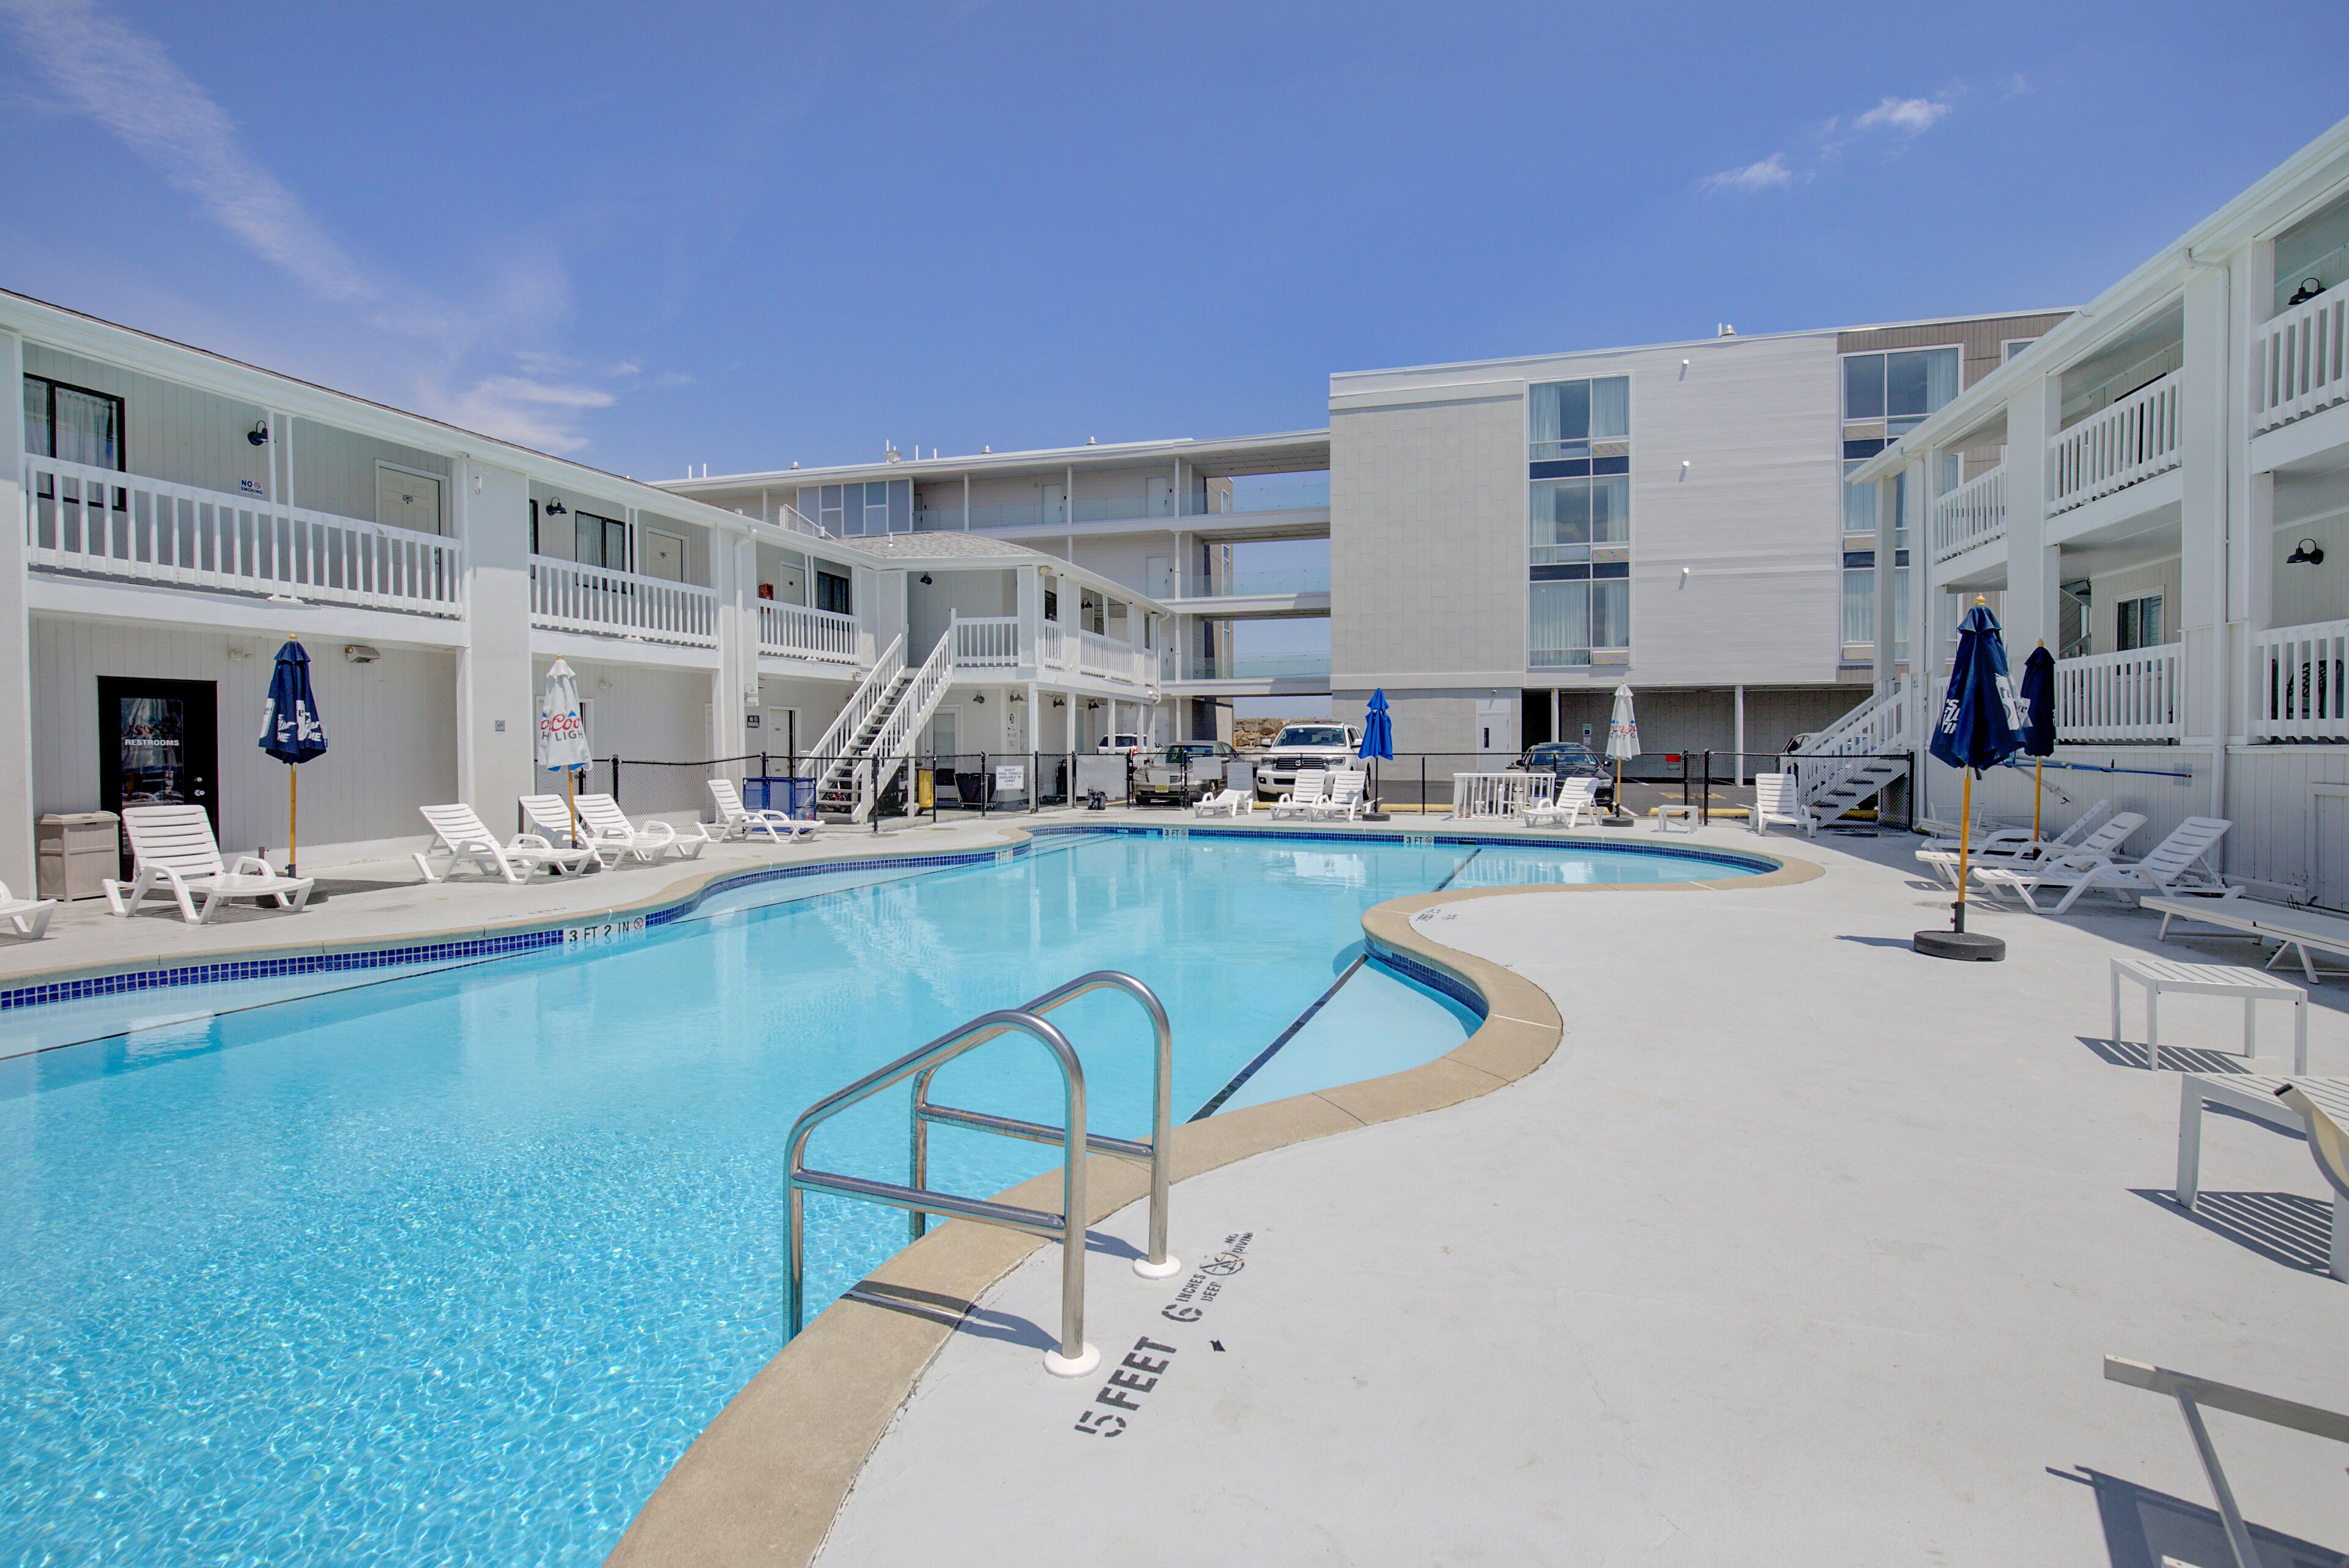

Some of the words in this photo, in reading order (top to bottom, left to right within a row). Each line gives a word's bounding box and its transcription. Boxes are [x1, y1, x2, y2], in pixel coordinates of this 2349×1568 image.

[241, 479, 253, 488] NO
[569, 929, 577, 942] 3
[584, 926, 598, 940] FT
[604, 924, 612, 936] 2
[618, 920, 629, 934] IN
[1224, 1233, 1239, 1244] NO
[1231, 1232, 1253, 1254] DIVIN
[1175, 1274, 1206, 1302] INCHES
[1200, 1281, 1222, 1302] DEEP
[1095, 1336, 1177, 1411] FEET
